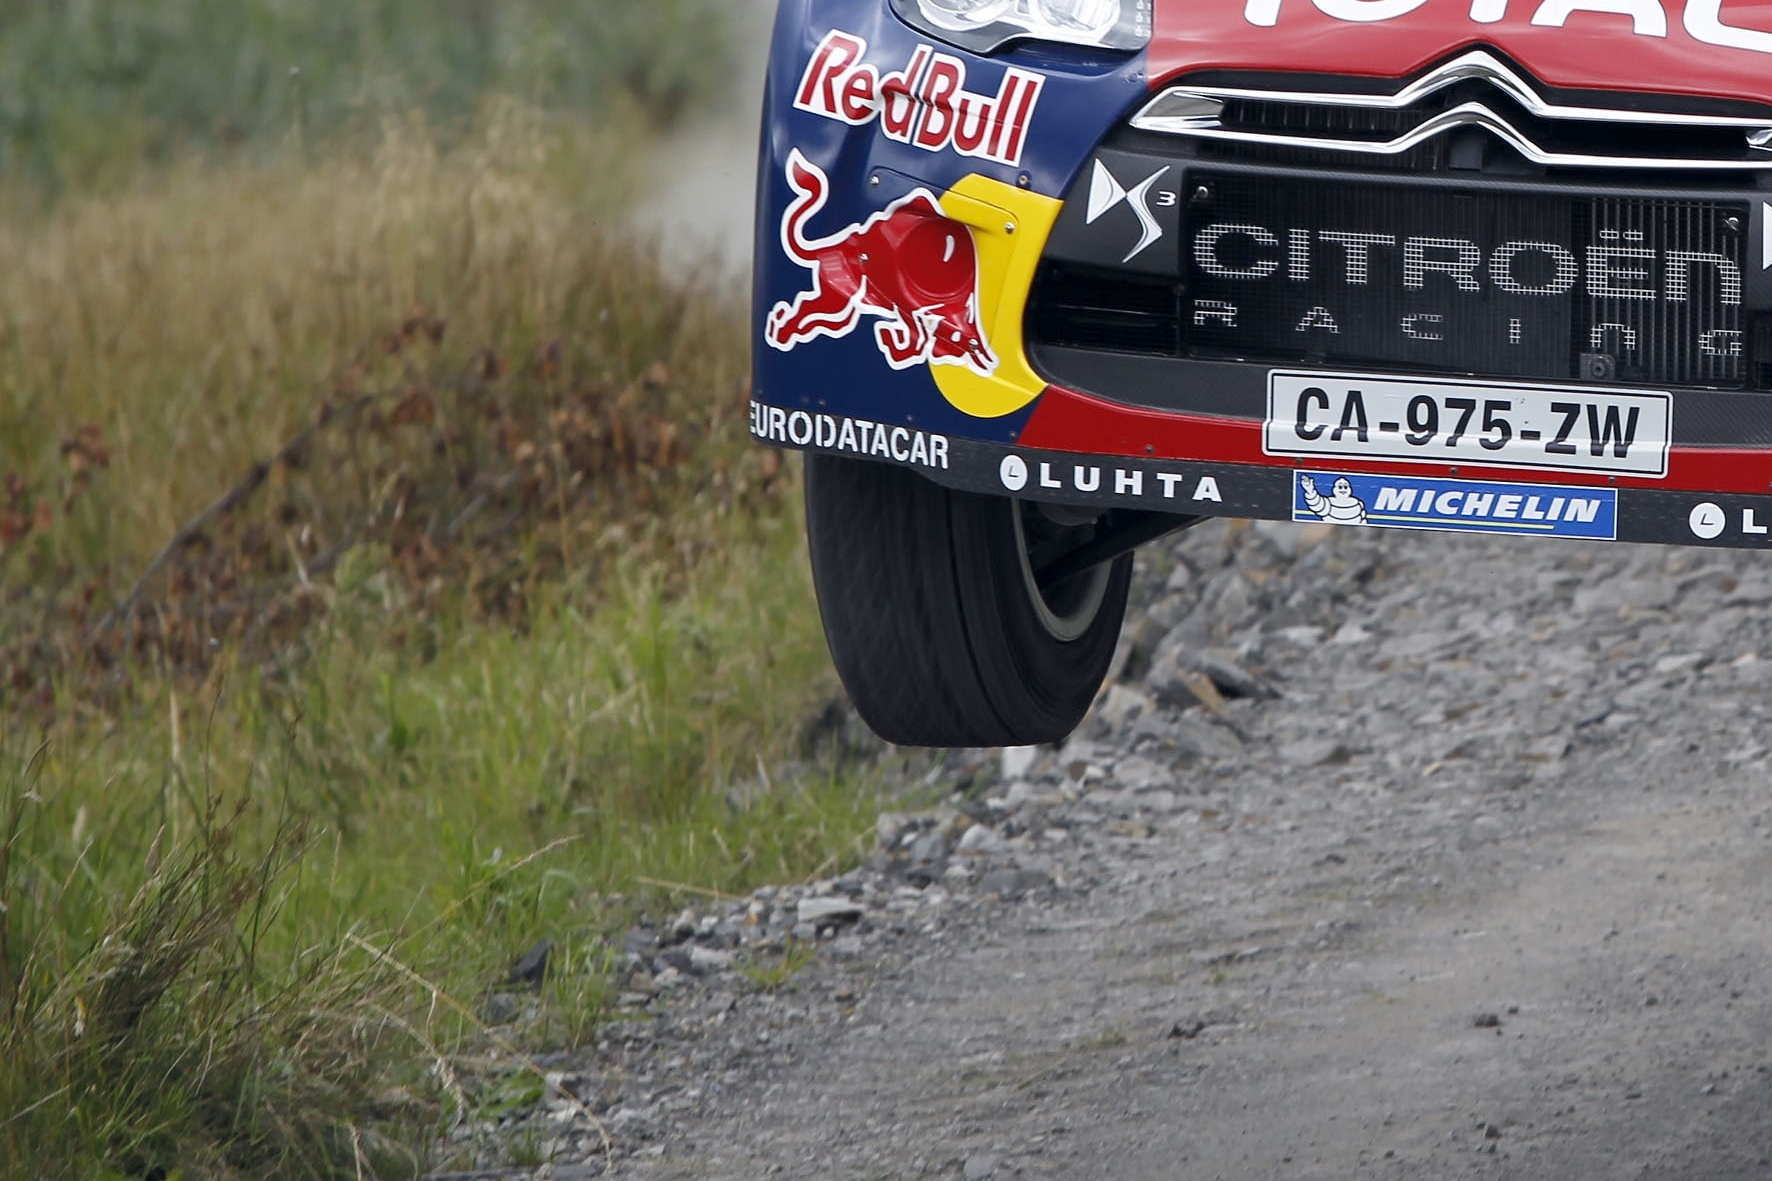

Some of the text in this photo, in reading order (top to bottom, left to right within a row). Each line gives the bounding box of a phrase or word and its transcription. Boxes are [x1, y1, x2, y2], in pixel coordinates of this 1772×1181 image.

[793, 28, 1046, 168] Red Bull
[1296, 386, 1640, 459] CA-975-ZW
[1040, 462, 1223, 503] LUHTA
[1374, 486, 1601, 523] MICHELIN
